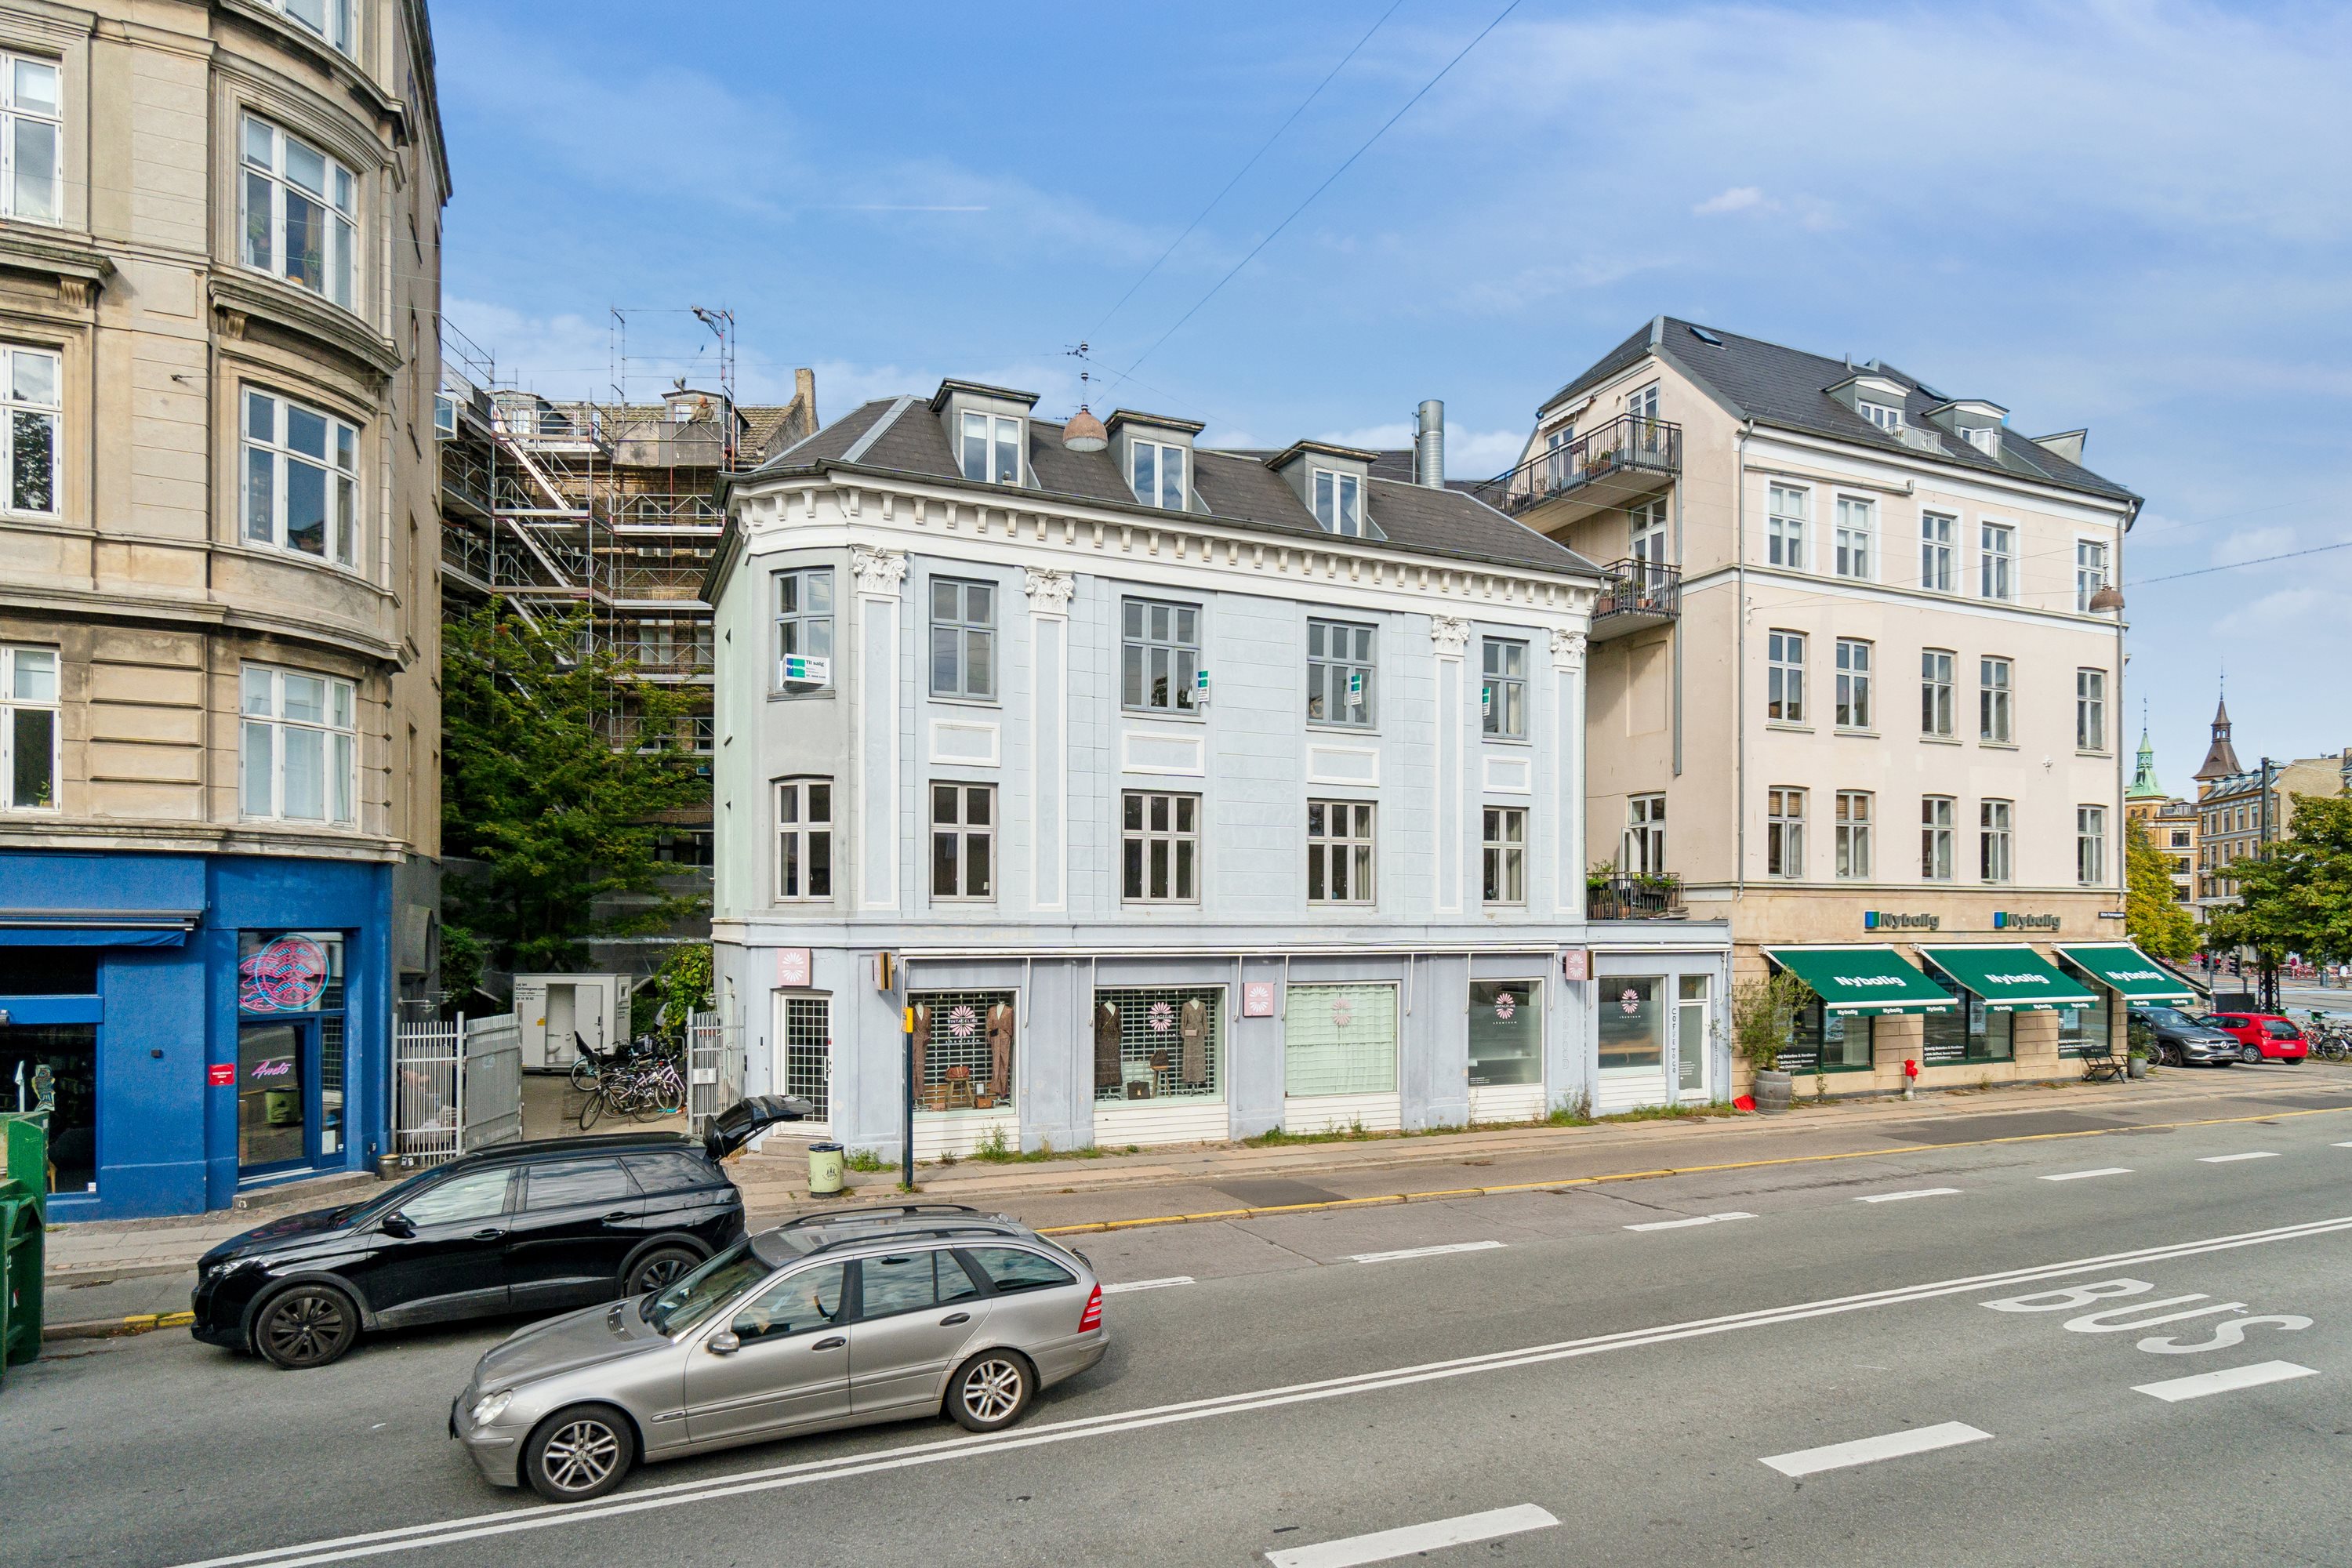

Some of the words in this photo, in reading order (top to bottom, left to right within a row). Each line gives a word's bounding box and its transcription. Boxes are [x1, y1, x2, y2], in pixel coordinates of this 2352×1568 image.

[1881, 913, 1939, 930] Nybolig
[2009, 913, 2061, 930] Nybolig
[1833, 975, 1907, 987] Nybolig
[1984, 973, 2050, 985] Nybolig
[2105, 971, 2165, 982] Nybolig
[1978, 1278, 2314, 1354] BUS
